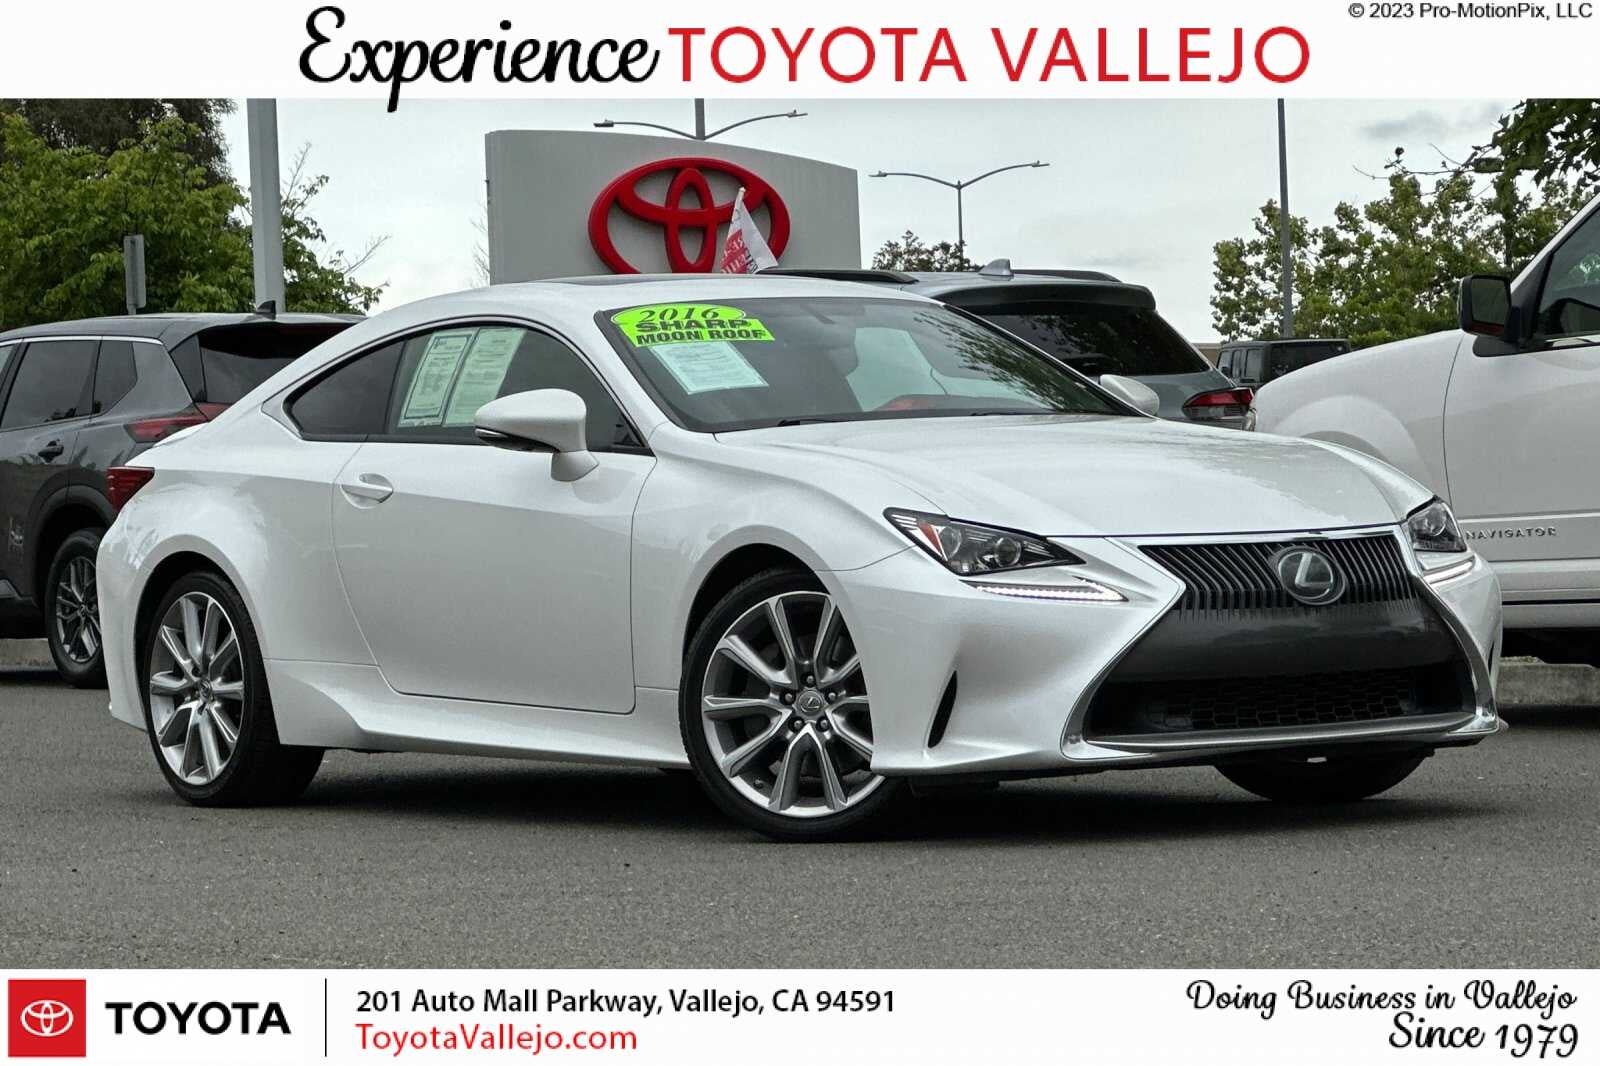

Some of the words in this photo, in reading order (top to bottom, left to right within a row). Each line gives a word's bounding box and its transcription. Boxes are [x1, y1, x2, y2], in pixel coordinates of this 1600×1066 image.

[639, 307, 720, 321] 2016
[636, 319, 748, 332] SHARP
[636, 330, 704, 345] MOON
[709, 329, 766, 340] ROOF
[1465, 527, 1557, 540] NAVIGATOR
